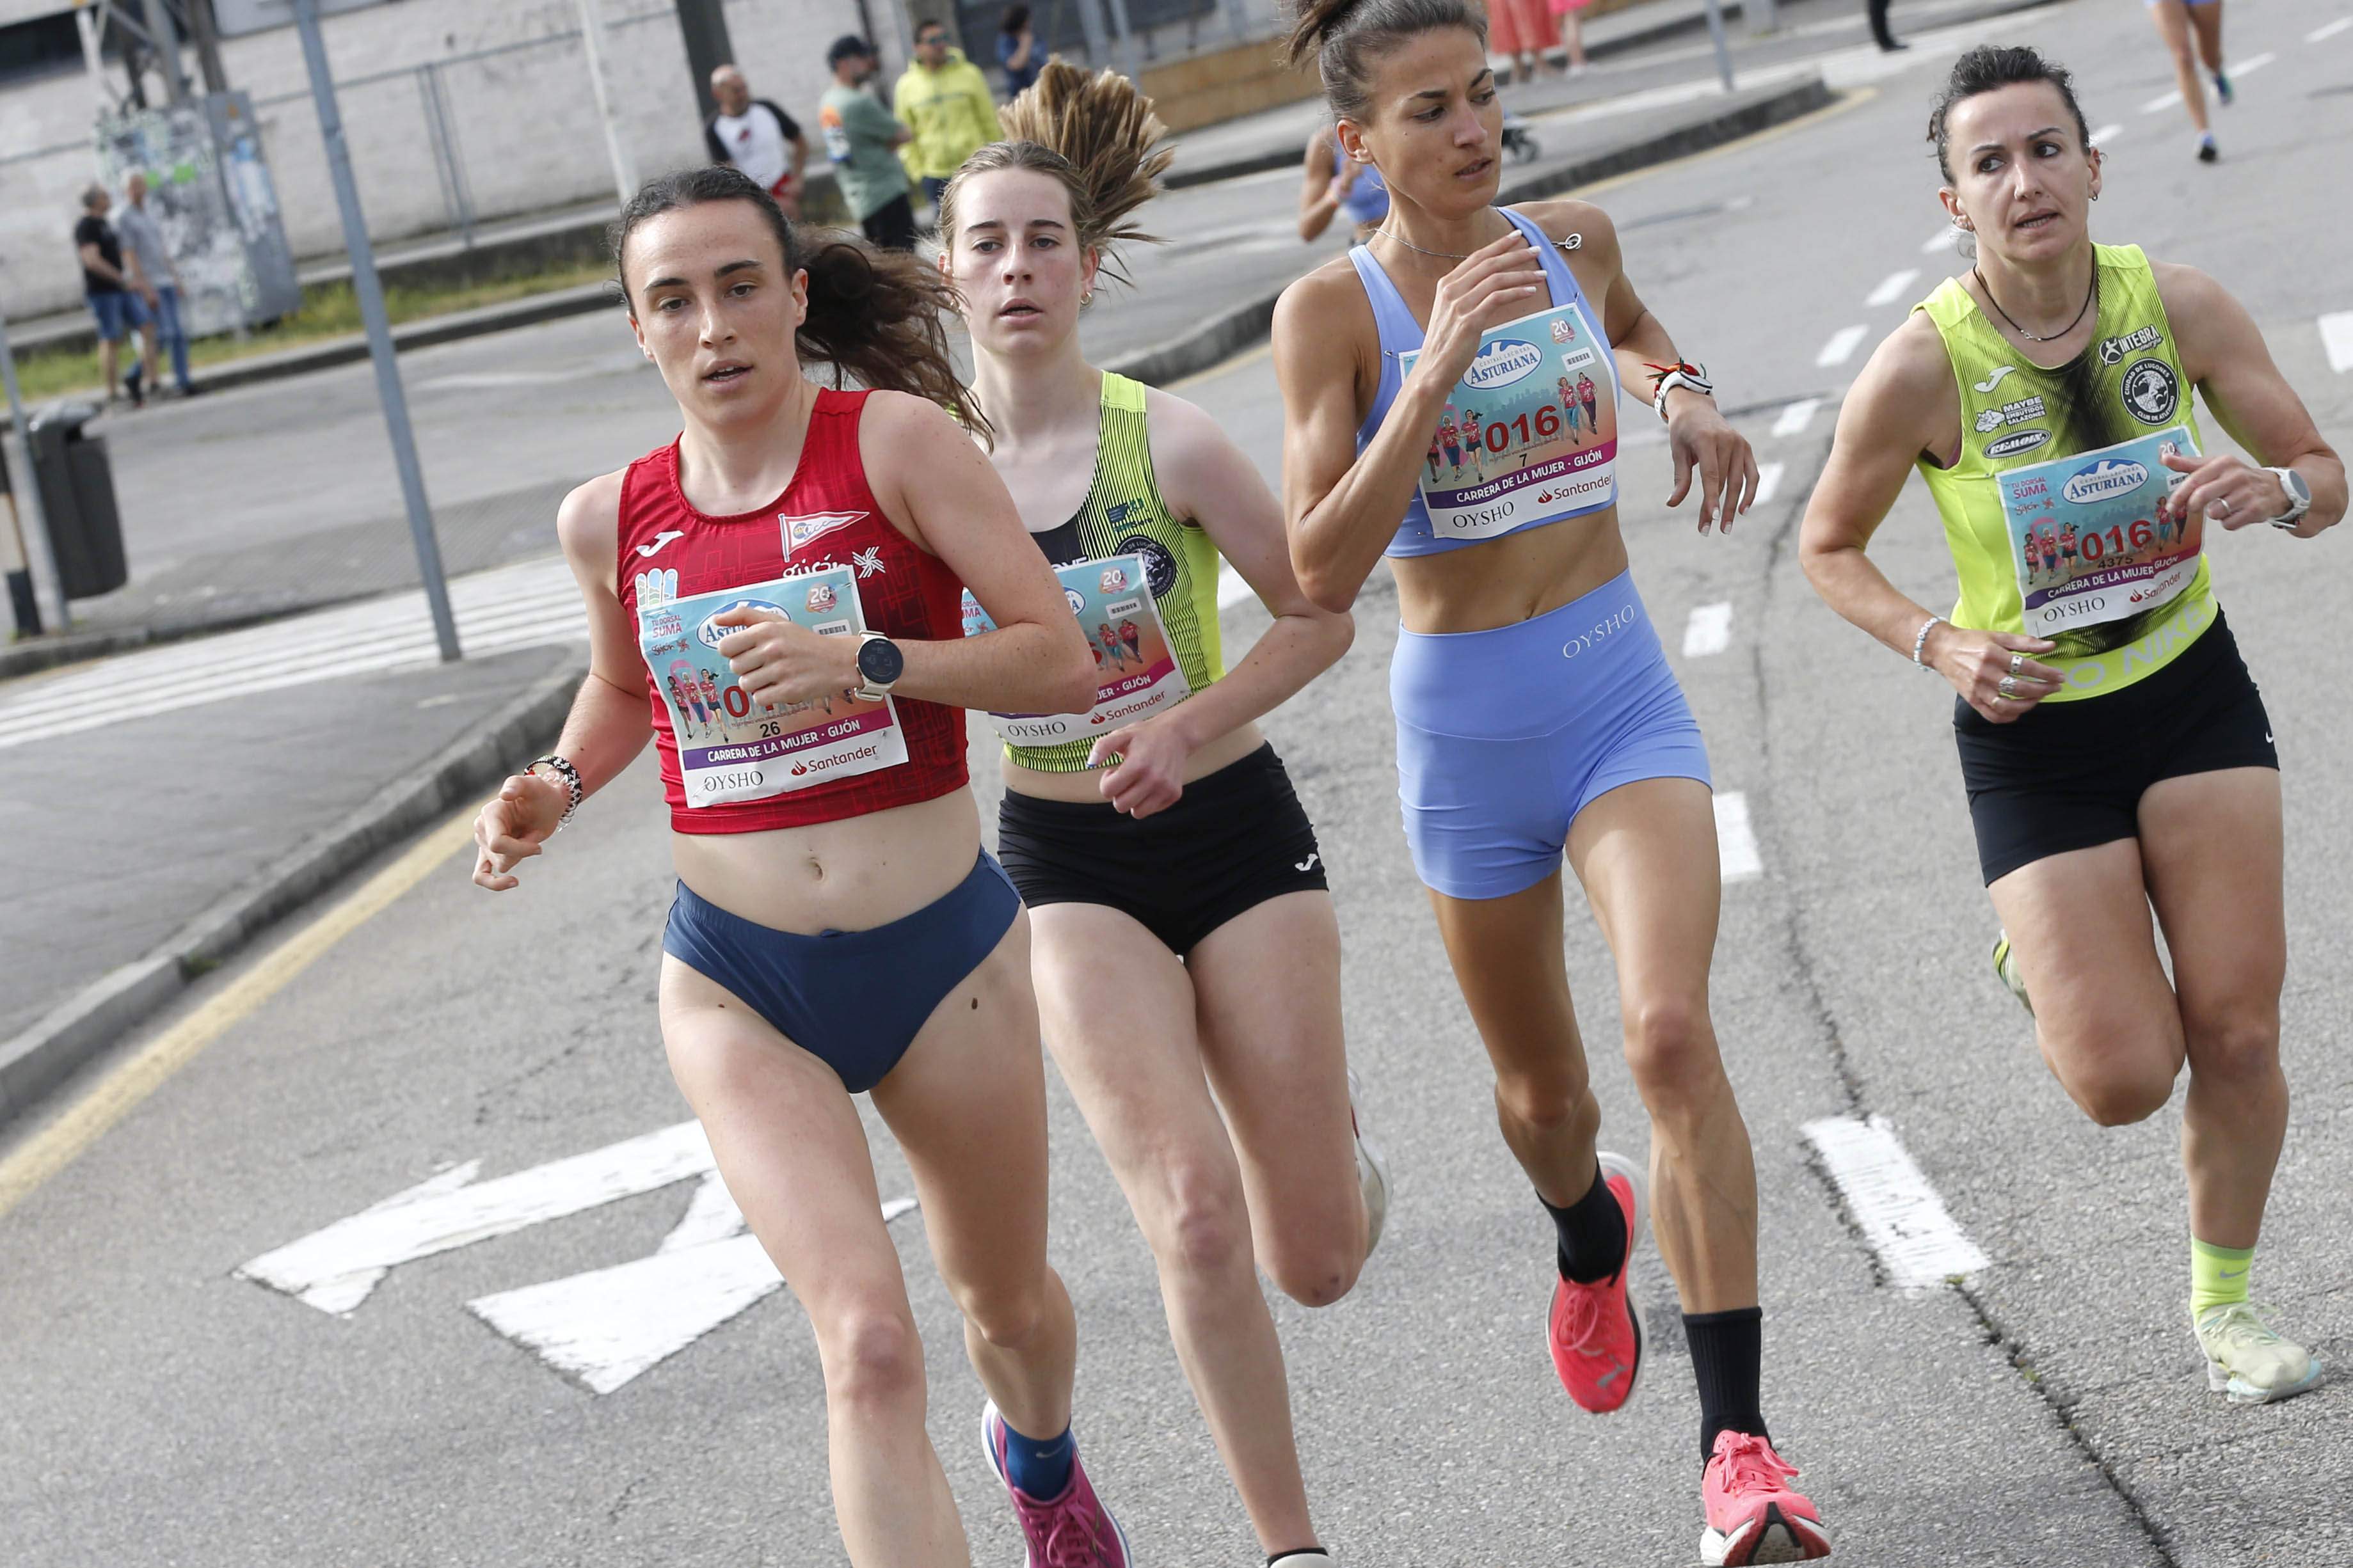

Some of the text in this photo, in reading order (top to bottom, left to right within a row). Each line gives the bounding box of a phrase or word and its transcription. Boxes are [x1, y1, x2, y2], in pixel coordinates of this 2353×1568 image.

[1551, 321, 1568, 336] 20
[2118, 325, 2159, 352] INTEGRA
[2125, 371, 2136, 395] CIUDAD
[2144, 363, 2170, 377] LUGONES
[2003, 396, 2043, 413] MAYBE
[2006, 405, 2044, 420] EMBUTIDOS
[2138, 411, 2151, 420] CLUB
[1485, 405, 1559, 453] 016
[2007, 411, 2045, 425] SALAZONES
[1519, 453, 1527, 467] 7
[1456, 482, 1501, 503] CARRERA
[1503, 476, 1515, 489] DE
[1517, 472, 1529, 484] LA
[1531, 461, 1565, 479] MUJER
[1574, 449, 1602, 466] GIJÓN
[1554, 475, 1612, 500] Santander
[2022, 477, 2046, 488] DORSAL
[2014, 483, 2047, 499] SUMA
[1453, 501, 1514, 528] OYSHO
[2081, 519, 2152, 561] 016
[2097, 557, 2134, 569] 4375
[1103, 570, 1121, 585] 20
[2048, 578, 2090, 598] CARRERA
[2093, 574, 2105, 585] DE
[2108, 571, 2120, 582] LA
[2122, 566, 2154, 579] MUJER
[2144, 572, 2181, 600] Saander
[659, 615, 682, 626] DORSAL
[2044, 597, 2105, 622] OYSHO
[652, 622, 683, 638] SUMA
[1563, 605, 1634, 658] OYSHO
[2123, 602, 2207, 676] NIKE
[1097, 674, 1151, 700] JER GIJÓN
[1106, 690, 1165, 721] Santander
[707, 719, 861, 763] CARRERA DE LA MUJER GIJÓN
[760, 721, 781, 738] 26
[1008, 721, 1066, 737] OYSHO
[808, 745, 877, 772] Santander
[704, 770, 763, 792] OYSHO
